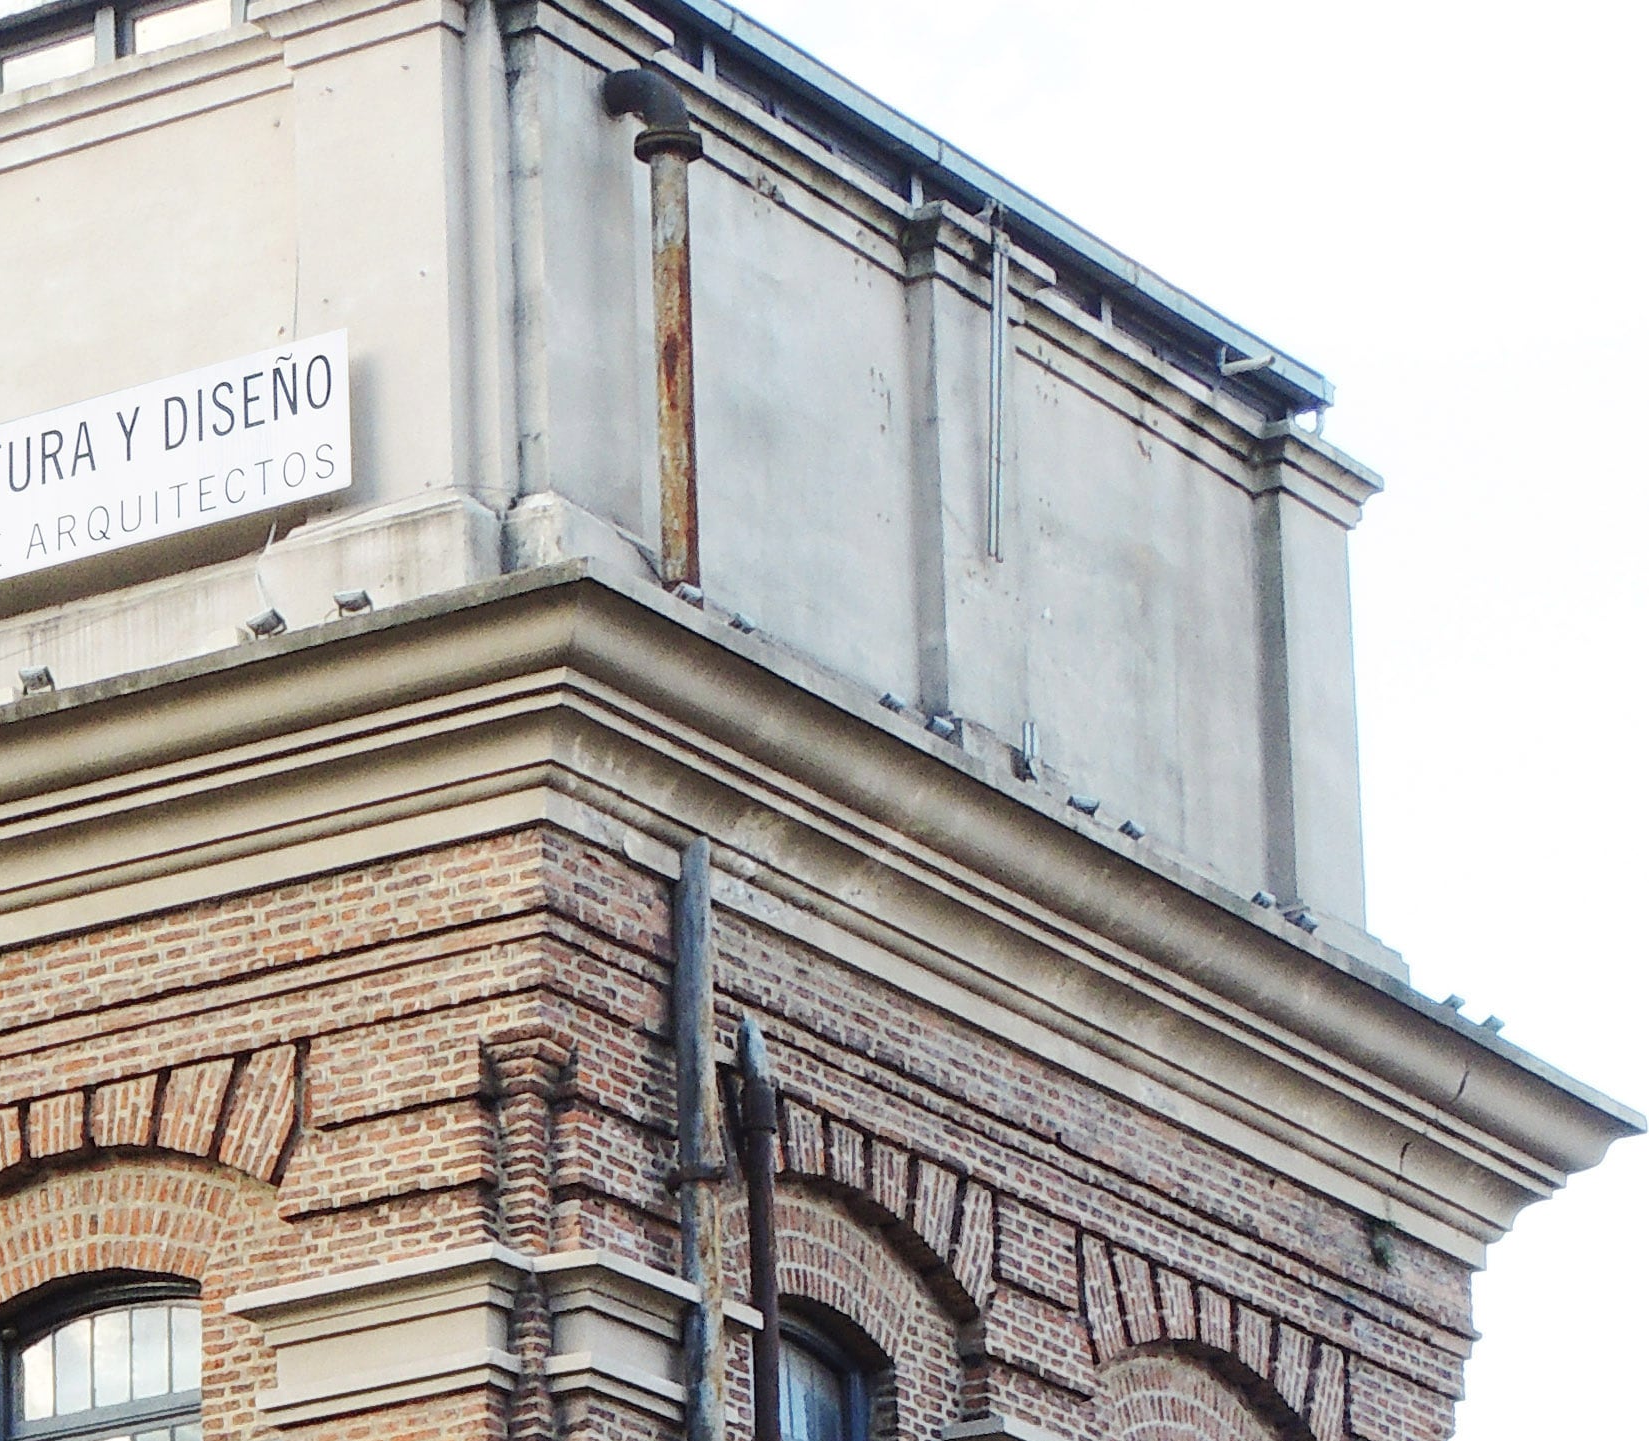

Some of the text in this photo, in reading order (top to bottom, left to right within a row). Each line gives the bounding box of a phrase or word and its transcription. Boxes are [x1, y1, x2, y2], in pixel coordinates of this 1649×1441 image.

[117, 406, 141, 462] Y
[165, 353, 332, 450] DISEÑO
[27, 443, 334, 559] ARQUITECTOS
